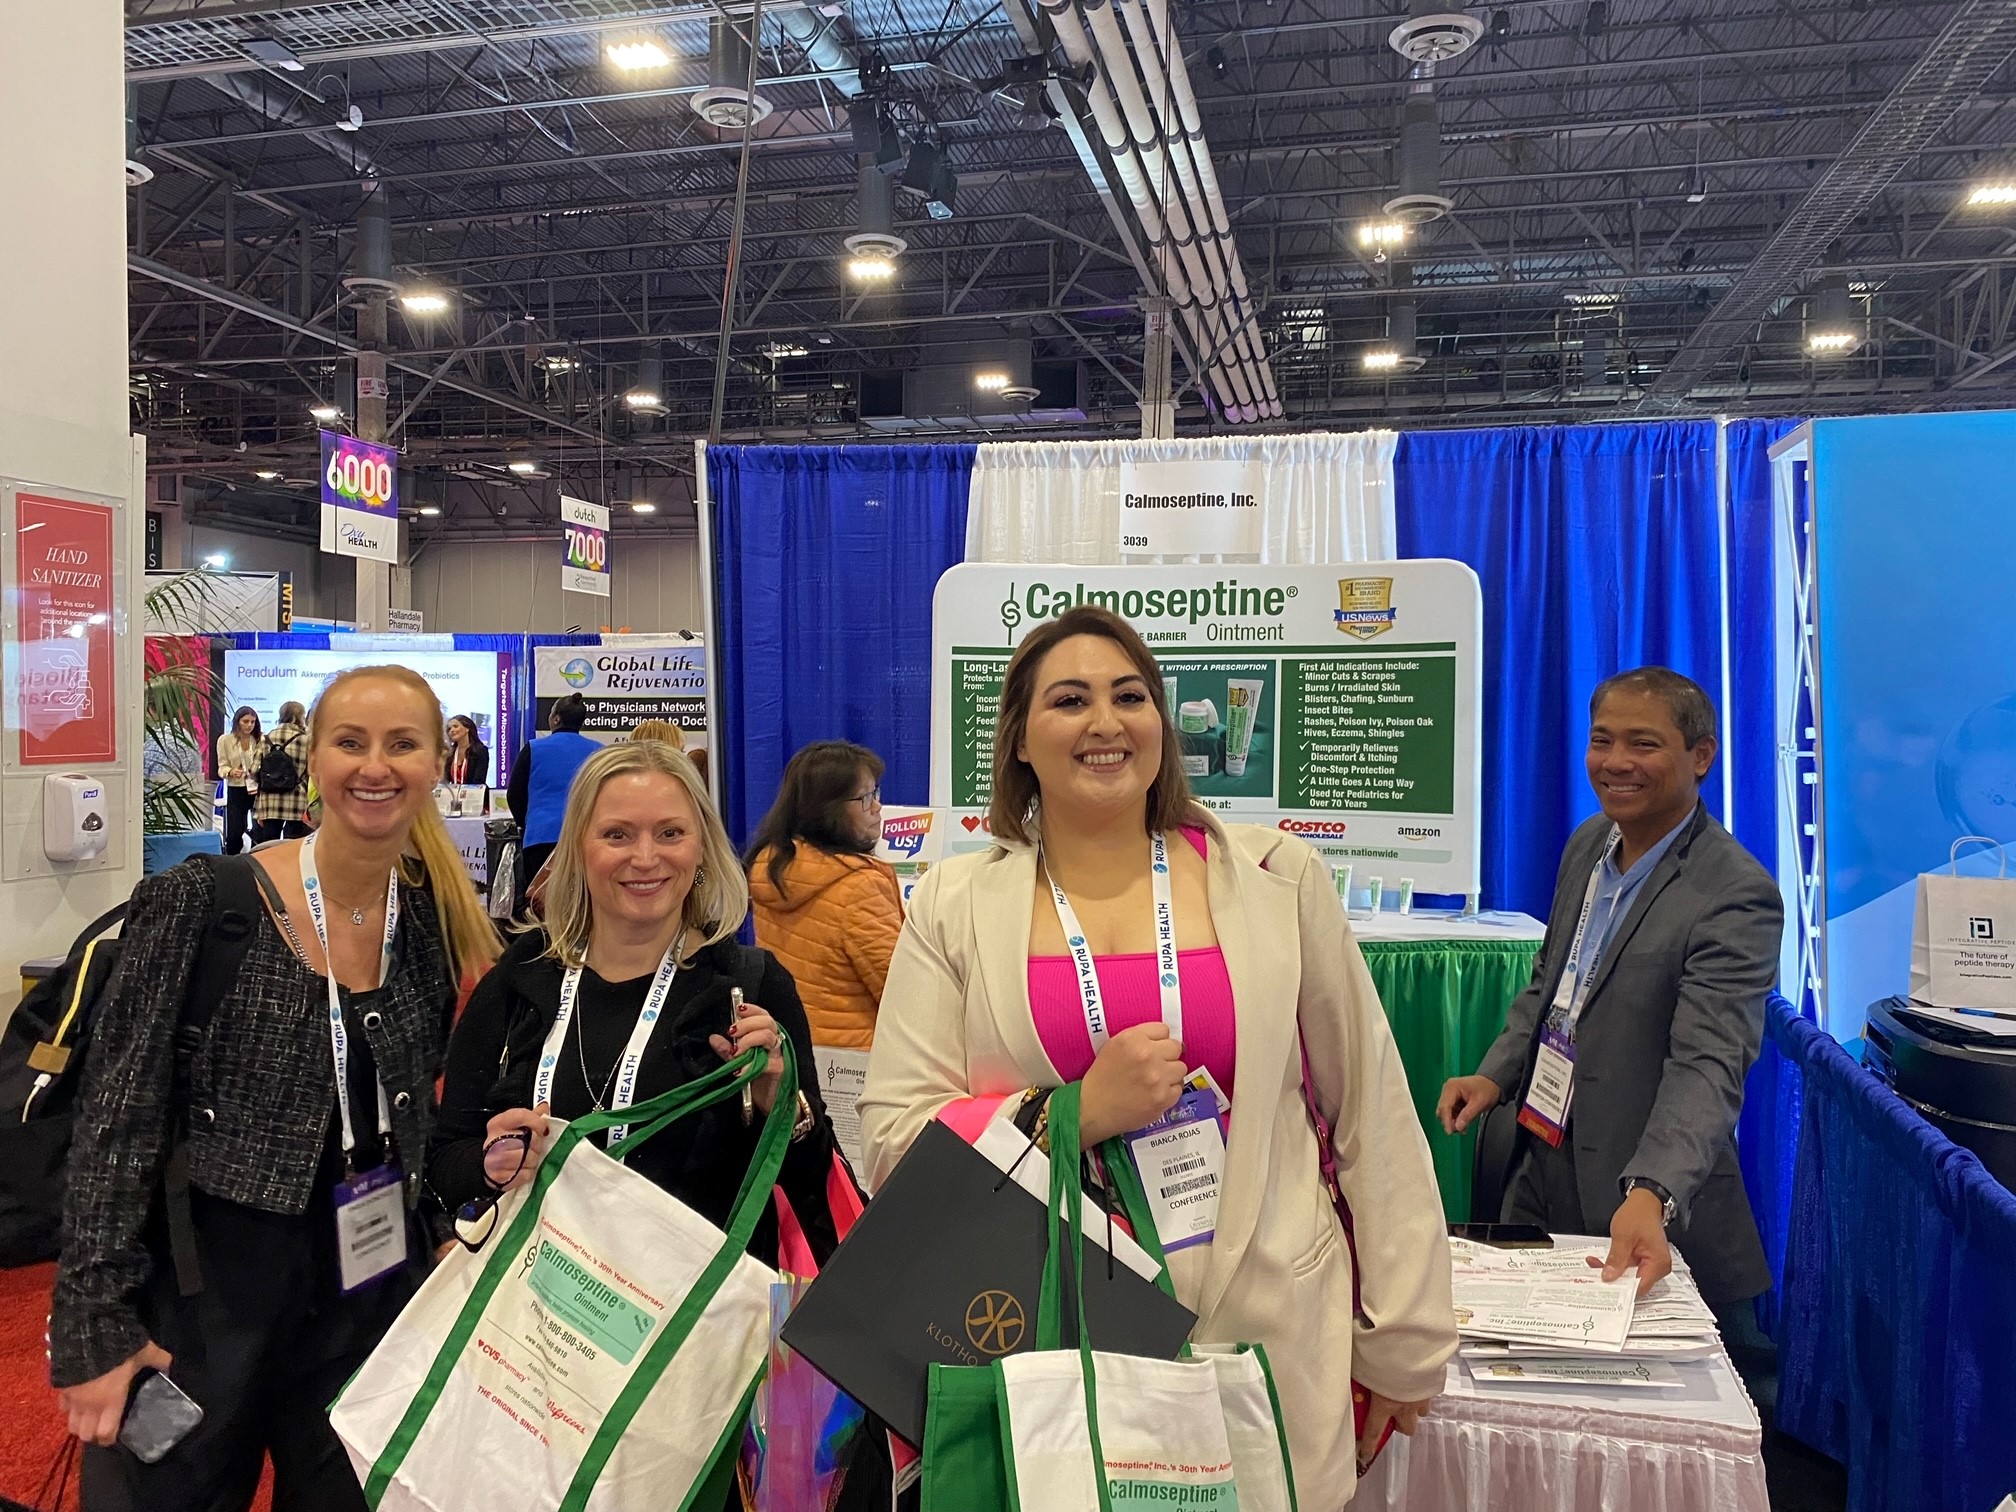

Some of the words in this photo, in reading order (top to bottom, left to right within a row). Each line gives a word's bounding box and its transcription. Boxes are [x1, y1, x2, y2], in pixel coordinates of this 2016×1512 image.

[326, 450, 392, 502] 6000
[1125, 493, 1228, 509] Calmoseptine,
[1231, 493, 1258, 507] Inc.
[574, 507, 596, 523] dutch
[348, 536, 378, 550] HEALTH
[565, 528, 605, 566] 7000
[1123, 536, 1148, 546] 3039
[46, 547, 88, 565] HAND
[31, 567, 102, 588] SANITIZER
[38, 598, 52, 606] Look
[54, 598, 62, 606] for
[63, 599, 73, 607] this
[87, 600, 95, 608] for
[40, 607, 68, 616] additional
[388, 610, 421, 622] Hallandale
[63, 617, 73, 625] the
[388, 620, 421, 631] Pharmacy
[1147, 632, 1187, 641] BARRIER
[1207, 623, 1283, 641] Ointment
[237, 666, 297, 678] Pendulum
[422, 672, 460, 680] Probiotics
[1299, 663, 1318, 671] First
[1320, 662, 1334, 671] Aid
[1336, 662, 1383, 671] Indications
[1385, 662, 1419, 670] Include:
[963, 674, 992, 682] Protects
[1331, 672, 1350, 680] Cuts
[1361, 672, 1396, 681] Scrapes
[963, 682, 985, 690] From:
[1338, 683, 1379, 691] Irradiated
[1382, 683, 1400, 691] Skin
[1305, 695, 1339, 704] Blisters,
[1341, 695, 1376, 704] Chafing,
[598, 702, 658, 714] Physicians
[661, 702, 705, 712] Network
[1305, 706, 1330, 714] Insect
[1332, 706, 1353, 714] Bites
[1304, 717, 1337, 727] Rashes,
[1339, 717, 1366, 726] Poison
[1369, 717, 1384, 727] Ivy,
[1386, 717, 1414, 726] Poison
[1417, 717, 1433, 726] Oak
[1304, 729, 1329, 738] Hives,
[1331, 729, 1366, 738] Eczema,
[1368, 729, 1405, 739] Shingles
[1311, 743, 1360, 753] Temporarily
[1363, 744, 1398, 752] Relieves
[1311, 753, 1356, 761] Discomfort
[1368, 753, 1398, 764] Itching
[1310, 765, 1349, 775] One-Step
[1351, 765, 1395, 774] Protection
[1310, 777, 1316, 785] A
[1319, 777, 1340, 785] Little
[1342, 778, 1362, 786] Goes
[1365, 778, 1370, 786] A
[1373, 778, 1394, 788] Long
[1396, 779, 1414, 789] Way
[1310, 789, 1330, 798] Used
[1333, 789, 1344, 798] for
[1347, 790, 1390, 799] Pediatrics
[1392, 791, 1404, 799] for
[1310, 799, 1328, 807] Over
[1331, 799, 1342, 807] 70
[1344, 799, 1367, 808] Years
[884, 818, 928, 834] FOLLOW
[1278, 818, 1346, 834] COSTCO
[1398, 826, 1441, 837] amazon
[895, 834, 919, 848] US!
[1322, 848, 1349, 856] stores
[1351, 848, 1399, 859] nationwide
[309, 892, 322, 920] RUPA
[387, 912, 395, 939] RUPA
[1158, 903, 1170, 940] HEALTH
[1572, 937, 1582, 961] RUPA
[1579, 901, 1590, 936] HEALTH
[1163, 943, 1174, 970] RUPA
[1959, 951, 1974, 959] The
[1976, 951, 1998, 960] future
[2000, 952, 2008, 960] of
[1954, 959, 1984, 968] peptide
[1986, 961, 2015, 970] therapy
[649, 984, 666, 1009] RUPA
[1075, 948, 1090, 977] RUPA
[1084, 980, 1103, 1034] HEALTH
[555, 980, 575, 1021] HEALTH
[335, 1024, 343, 1054] RUPA
[618, 1054, 638, 1104] HEALTH
[537, 1071, 549, 1103] RUPA
[1150, 1135, 1178, 1148] BIANCA
[1179, 1127, 1201, 1140] ROJAS
[1169, 1189, 1218, 1210] CONFERENCE
[599, 1261, 613, 1275] 30th
[613, 1273, 627, 1286] Year
[627, 1283, 666, 1311] Anniversary
[574, 1292, 609, 1322] Ointment
[543, 1315, 597, 1361] 1-800-800-3405
[926, 1322, 978, 1367] KLOTHO
[504, 1384, 520, 1398] stores
[519, 1393, 546, 1420] nationwide
[476, 1385, 492, 1399] THE
[491, 1395, 519, 1422] ORIGINAL
[519, 1417, 538, 1438] SINCE
[532, 1386, 544, 1397] and
[546, 1396, 586, 1435] Walgreens
[1179, 1464, 1197, 1473] 30th
[1200, 1465, 1217, 1473] Year
